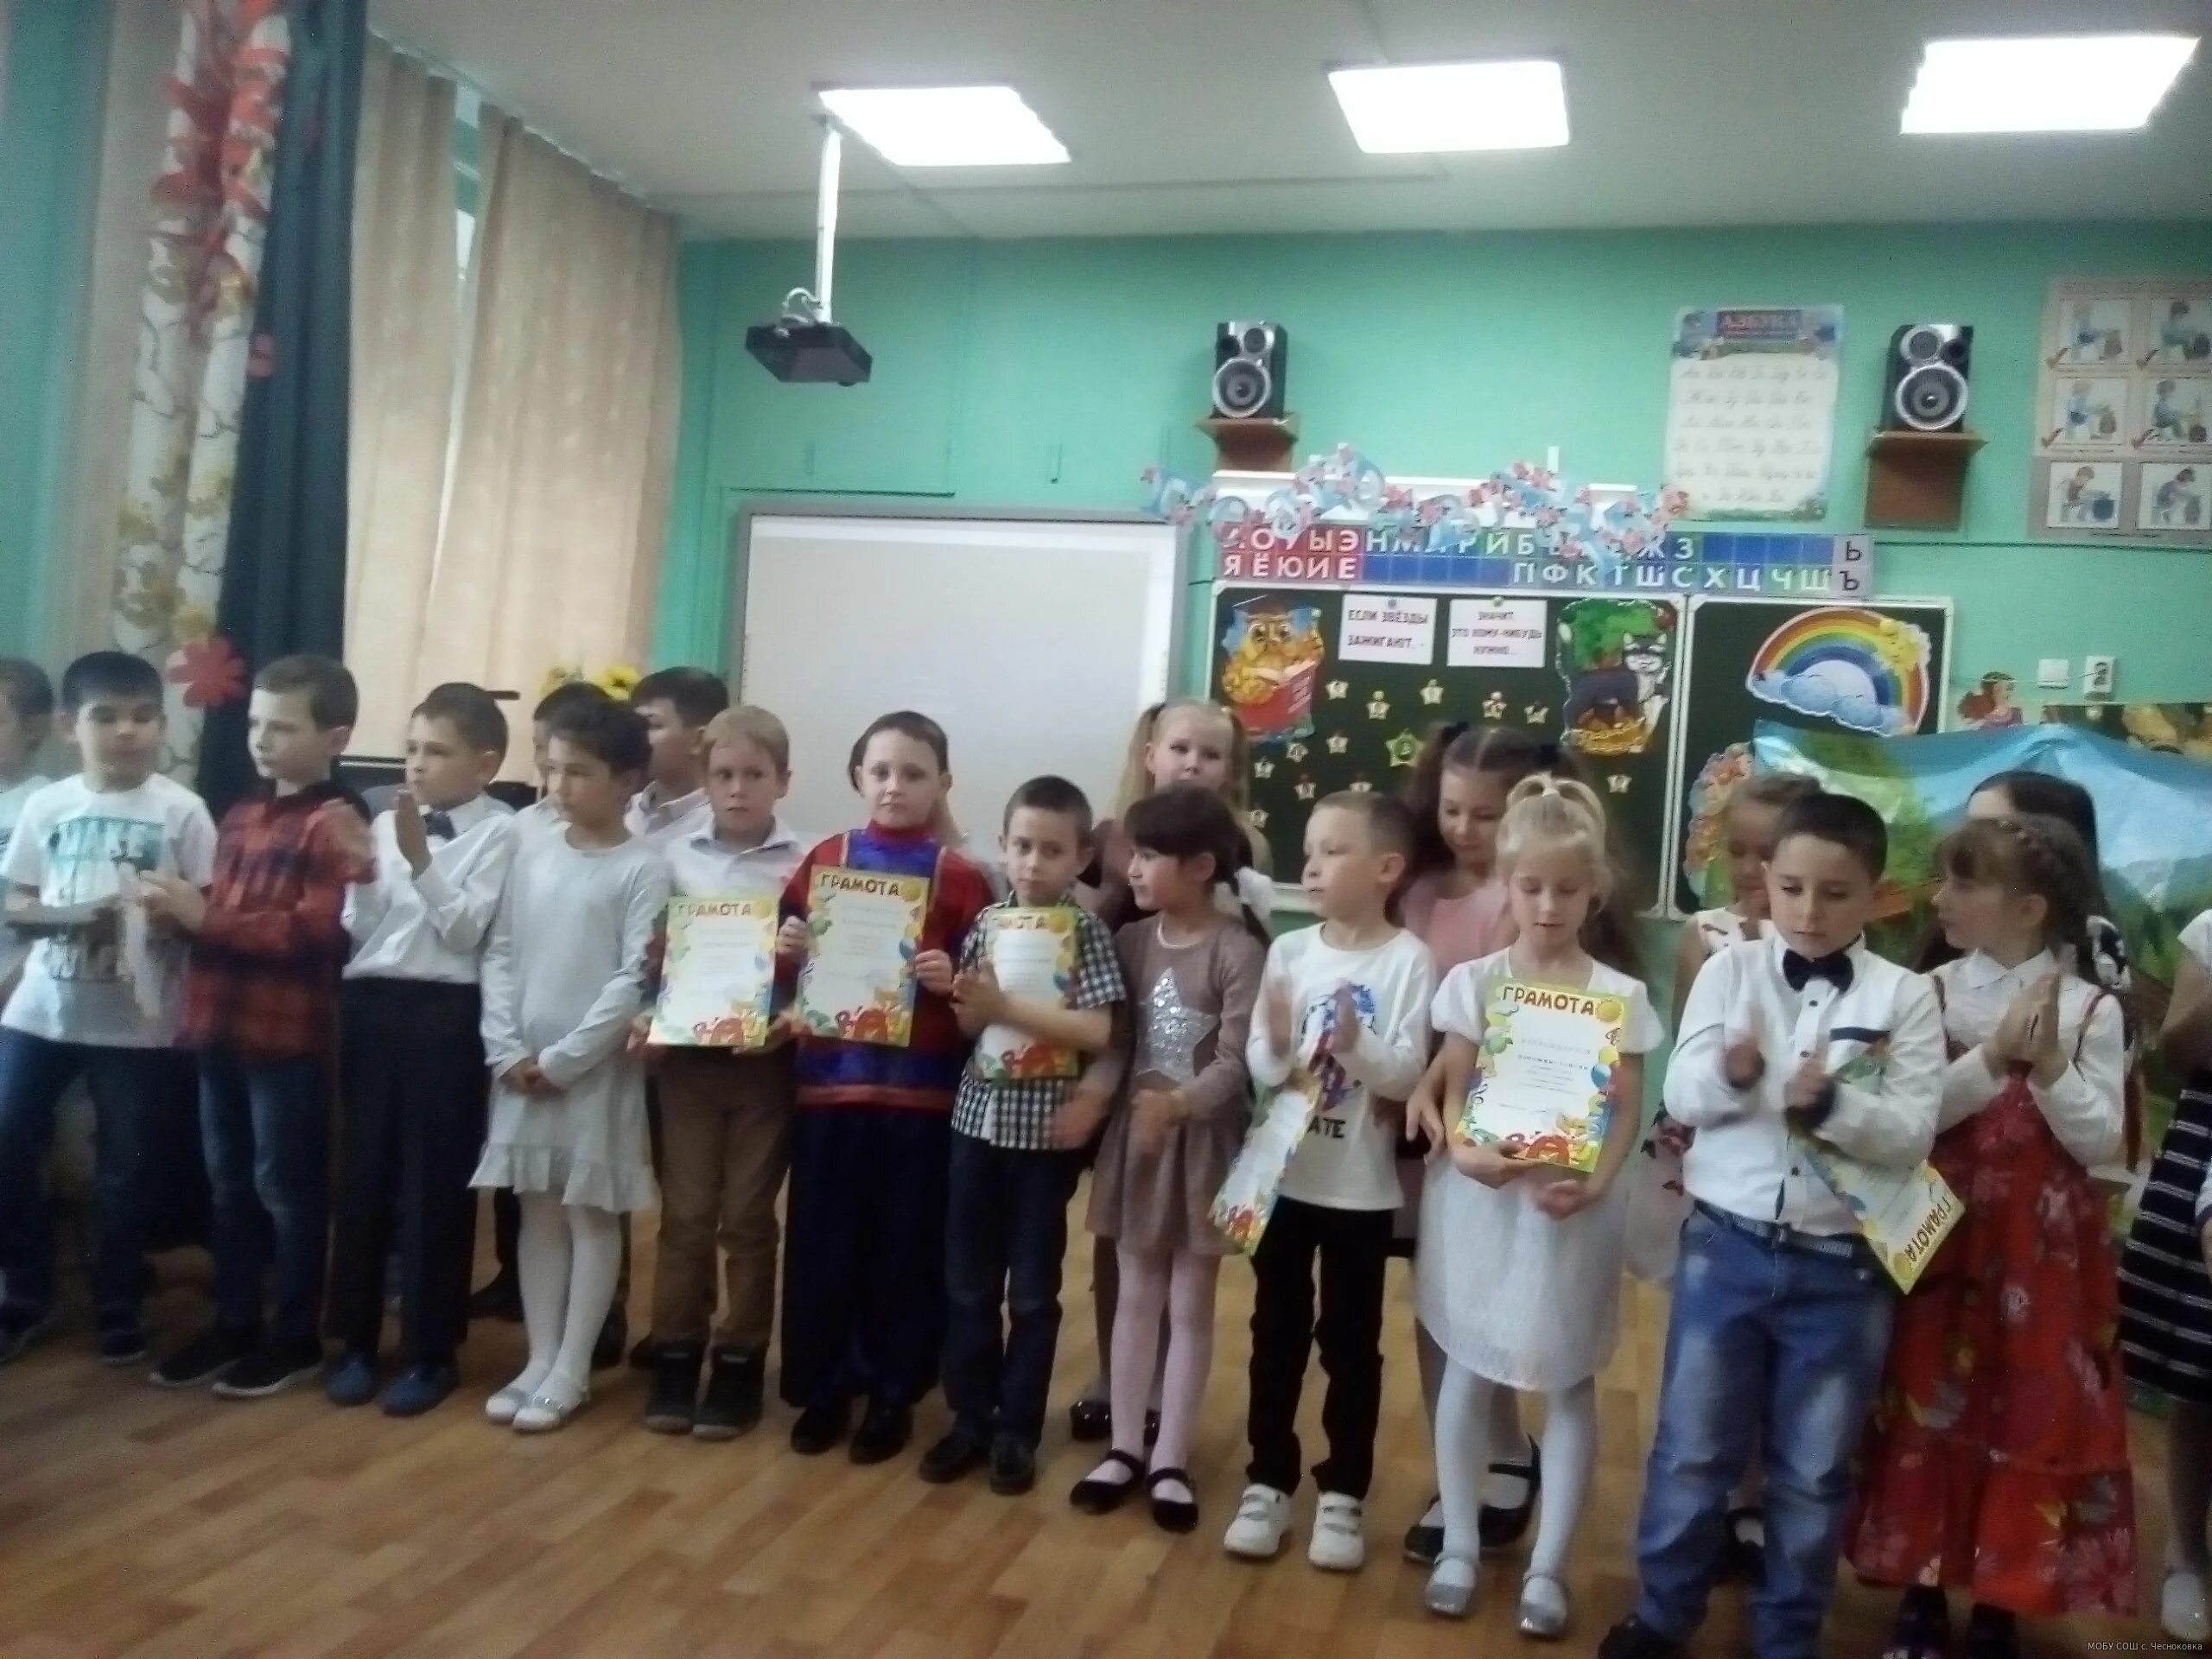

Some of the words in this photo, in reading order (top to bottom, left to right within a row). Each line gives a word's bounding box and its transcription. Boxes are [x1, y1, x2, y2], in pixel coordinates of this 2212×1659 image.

[820, 874, 900, 897] ГРАМОТА
[677, 903, 752, 918] ГРАМОТА
[1502, 986, 1594, 1015] ГРАМОТА
[1307, 1116, 1346, 1139] ATE
[1904, 1195, 1955, 1262] ГРАМОТА
